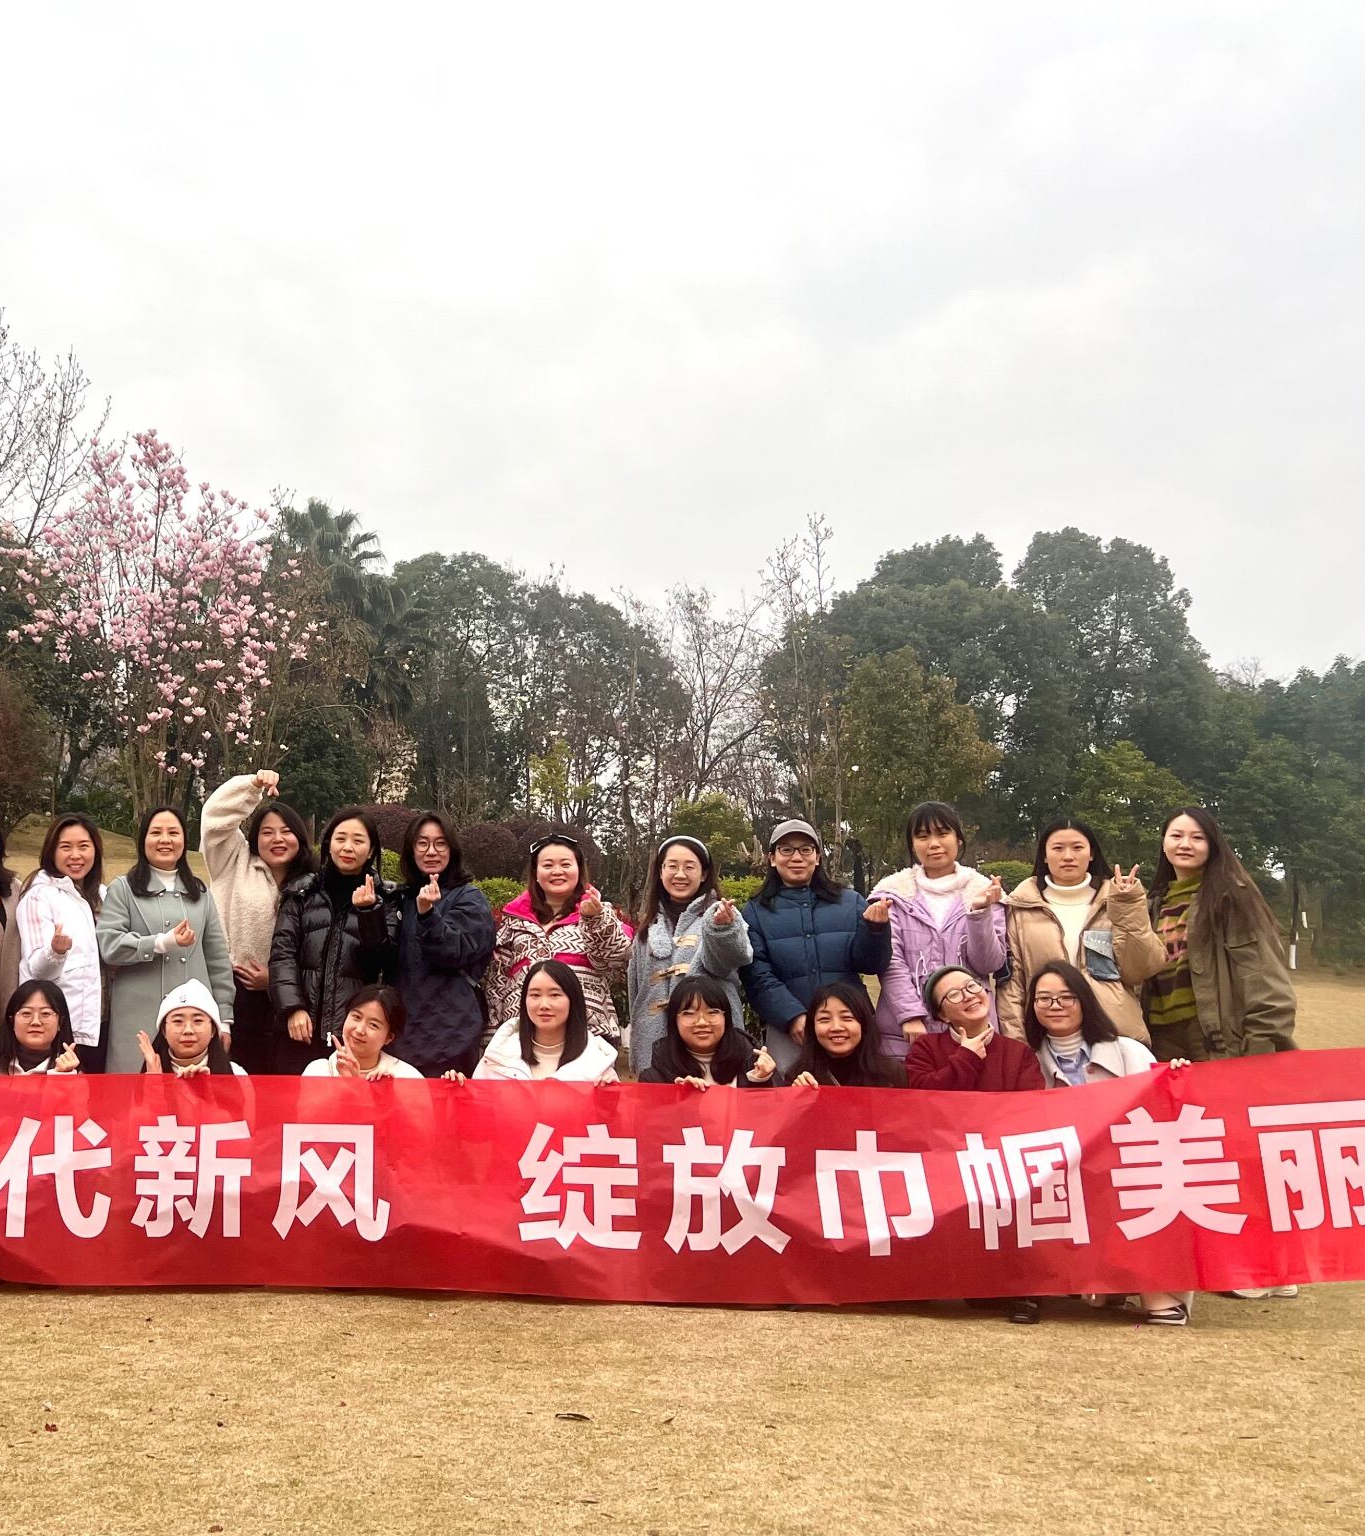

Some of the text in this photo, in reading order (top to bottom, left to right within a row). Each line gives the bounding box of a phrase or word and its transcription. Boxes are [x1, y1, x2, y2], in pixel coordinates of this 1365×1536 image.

[518, 1099, 1365, 1256] 绽放巾帼美丽
